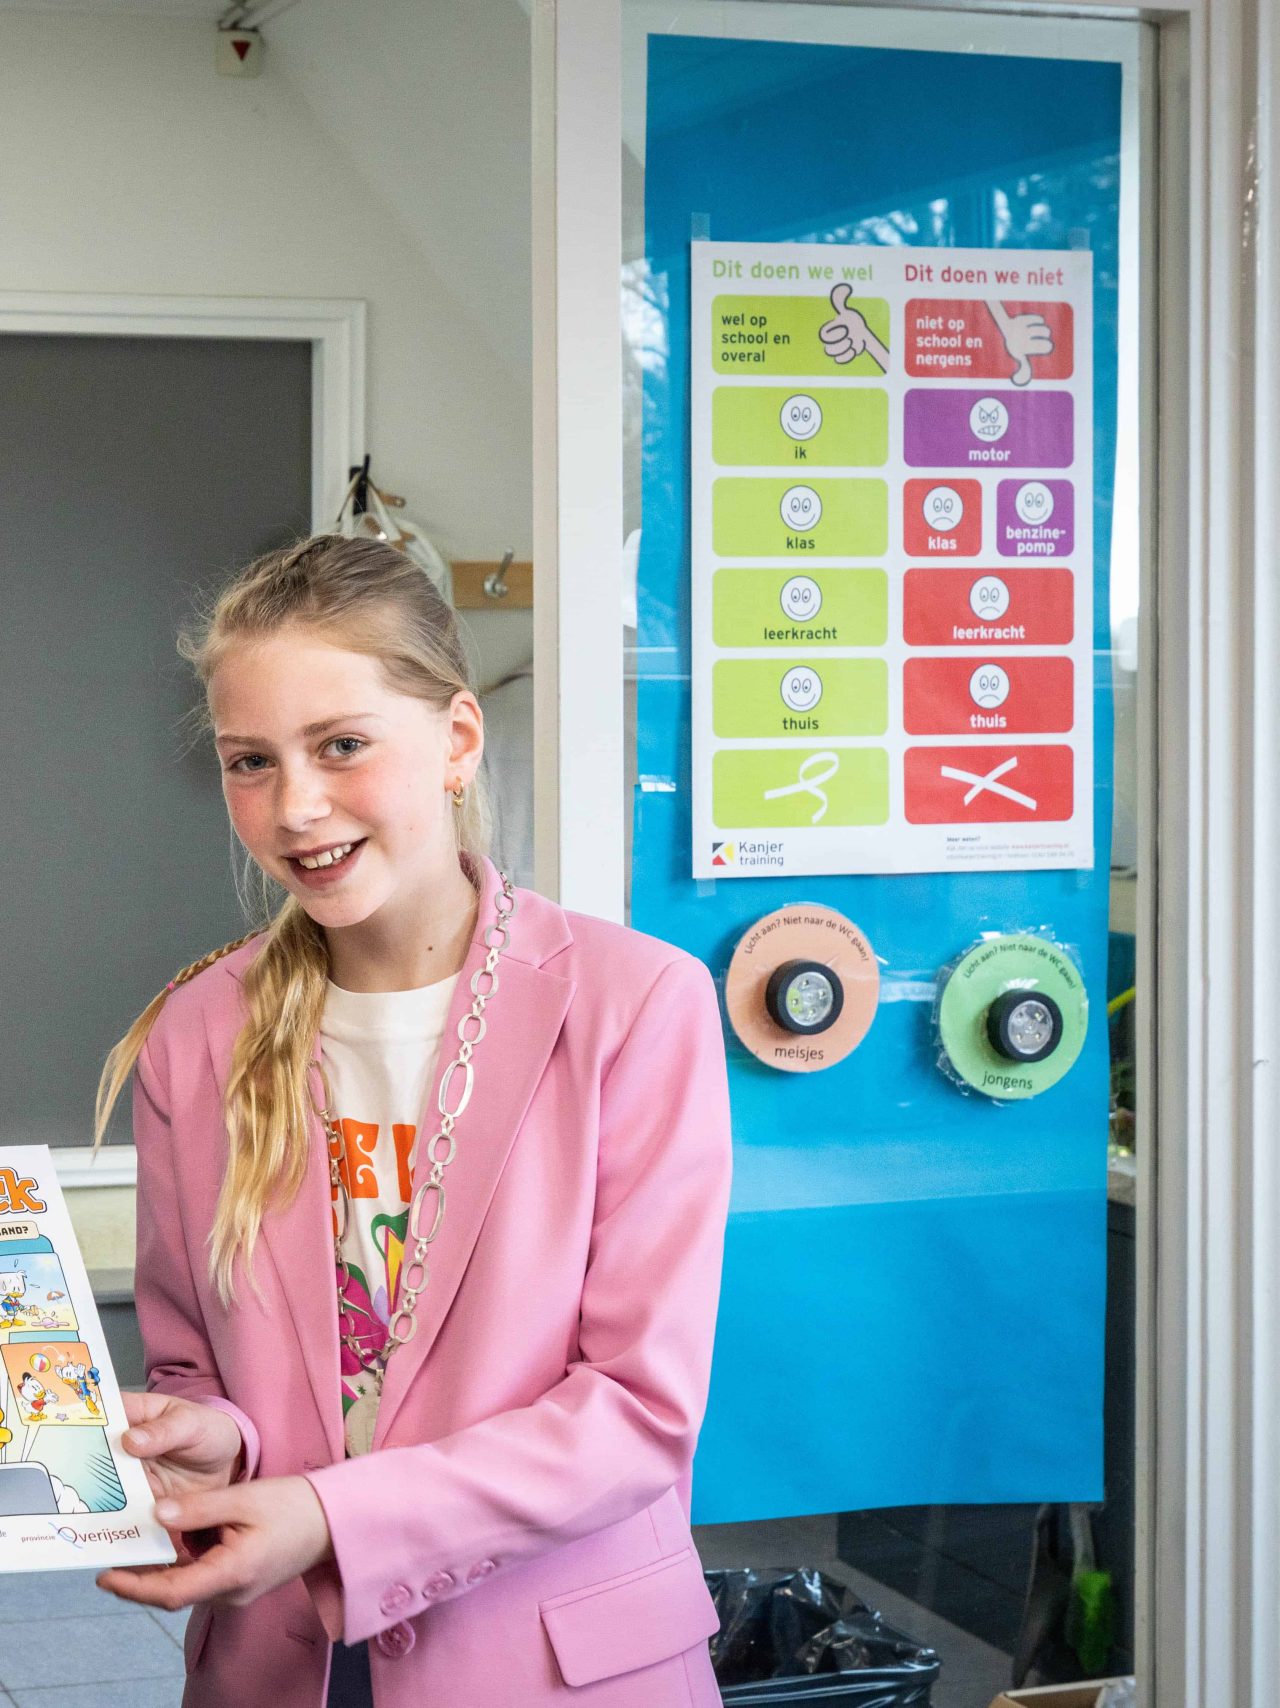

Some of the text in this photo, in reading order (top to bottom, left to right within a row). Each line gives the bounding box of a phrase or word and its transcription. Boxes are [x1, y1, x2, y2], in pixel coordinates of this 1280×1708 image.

[713, 260, 873, 280] Dit doen we wel
[905, 264, 1063, 285] Dit doen we niet
[721, 313, 767, 328] wel op
[916, 316, 964, 332] niet op
[721, 332, 790, 344] school en
[916, 334, 983, 348] school en
[721, 350, 765, 362] overal
[916, 354, 972, 368] nergens
[794, 446, 807, 460] ik
[968, 448, 1011, 462] motor
[1006, 525, 1066, 540] benzine-
[786, 536, 815, 550] klas
[927, 536, 957, 551] klas
[1017, 541, 1055, 556] pomp
[764, 627, 837, 641] leerkracht
[953, 625, 1025, 640] leerkracht
[782, 717, 819, 731] thuis
[970, 714, 1007, 729] thuis
[739, 841, 783, 856] Kanjer
[739, 854, 784, 867] training
[745, 916, 869, 961] Licht aan? Niet naar de WC gaan!
[963, 959, 980, 978] Licht
[981, 946, 998, 963] aan?
[1000, 943, 1016, 952] Niet
[1018, 944, 1036, 952] naar
[1038, 947, 1048, 957] de
[1049, 953, 1063, 968] WC
[774, 1046, 824, 1062] meisjes
[982, 1071, 1033, 1089] jongens
[21, 1525, 141, 1544] provincie Overijssel
